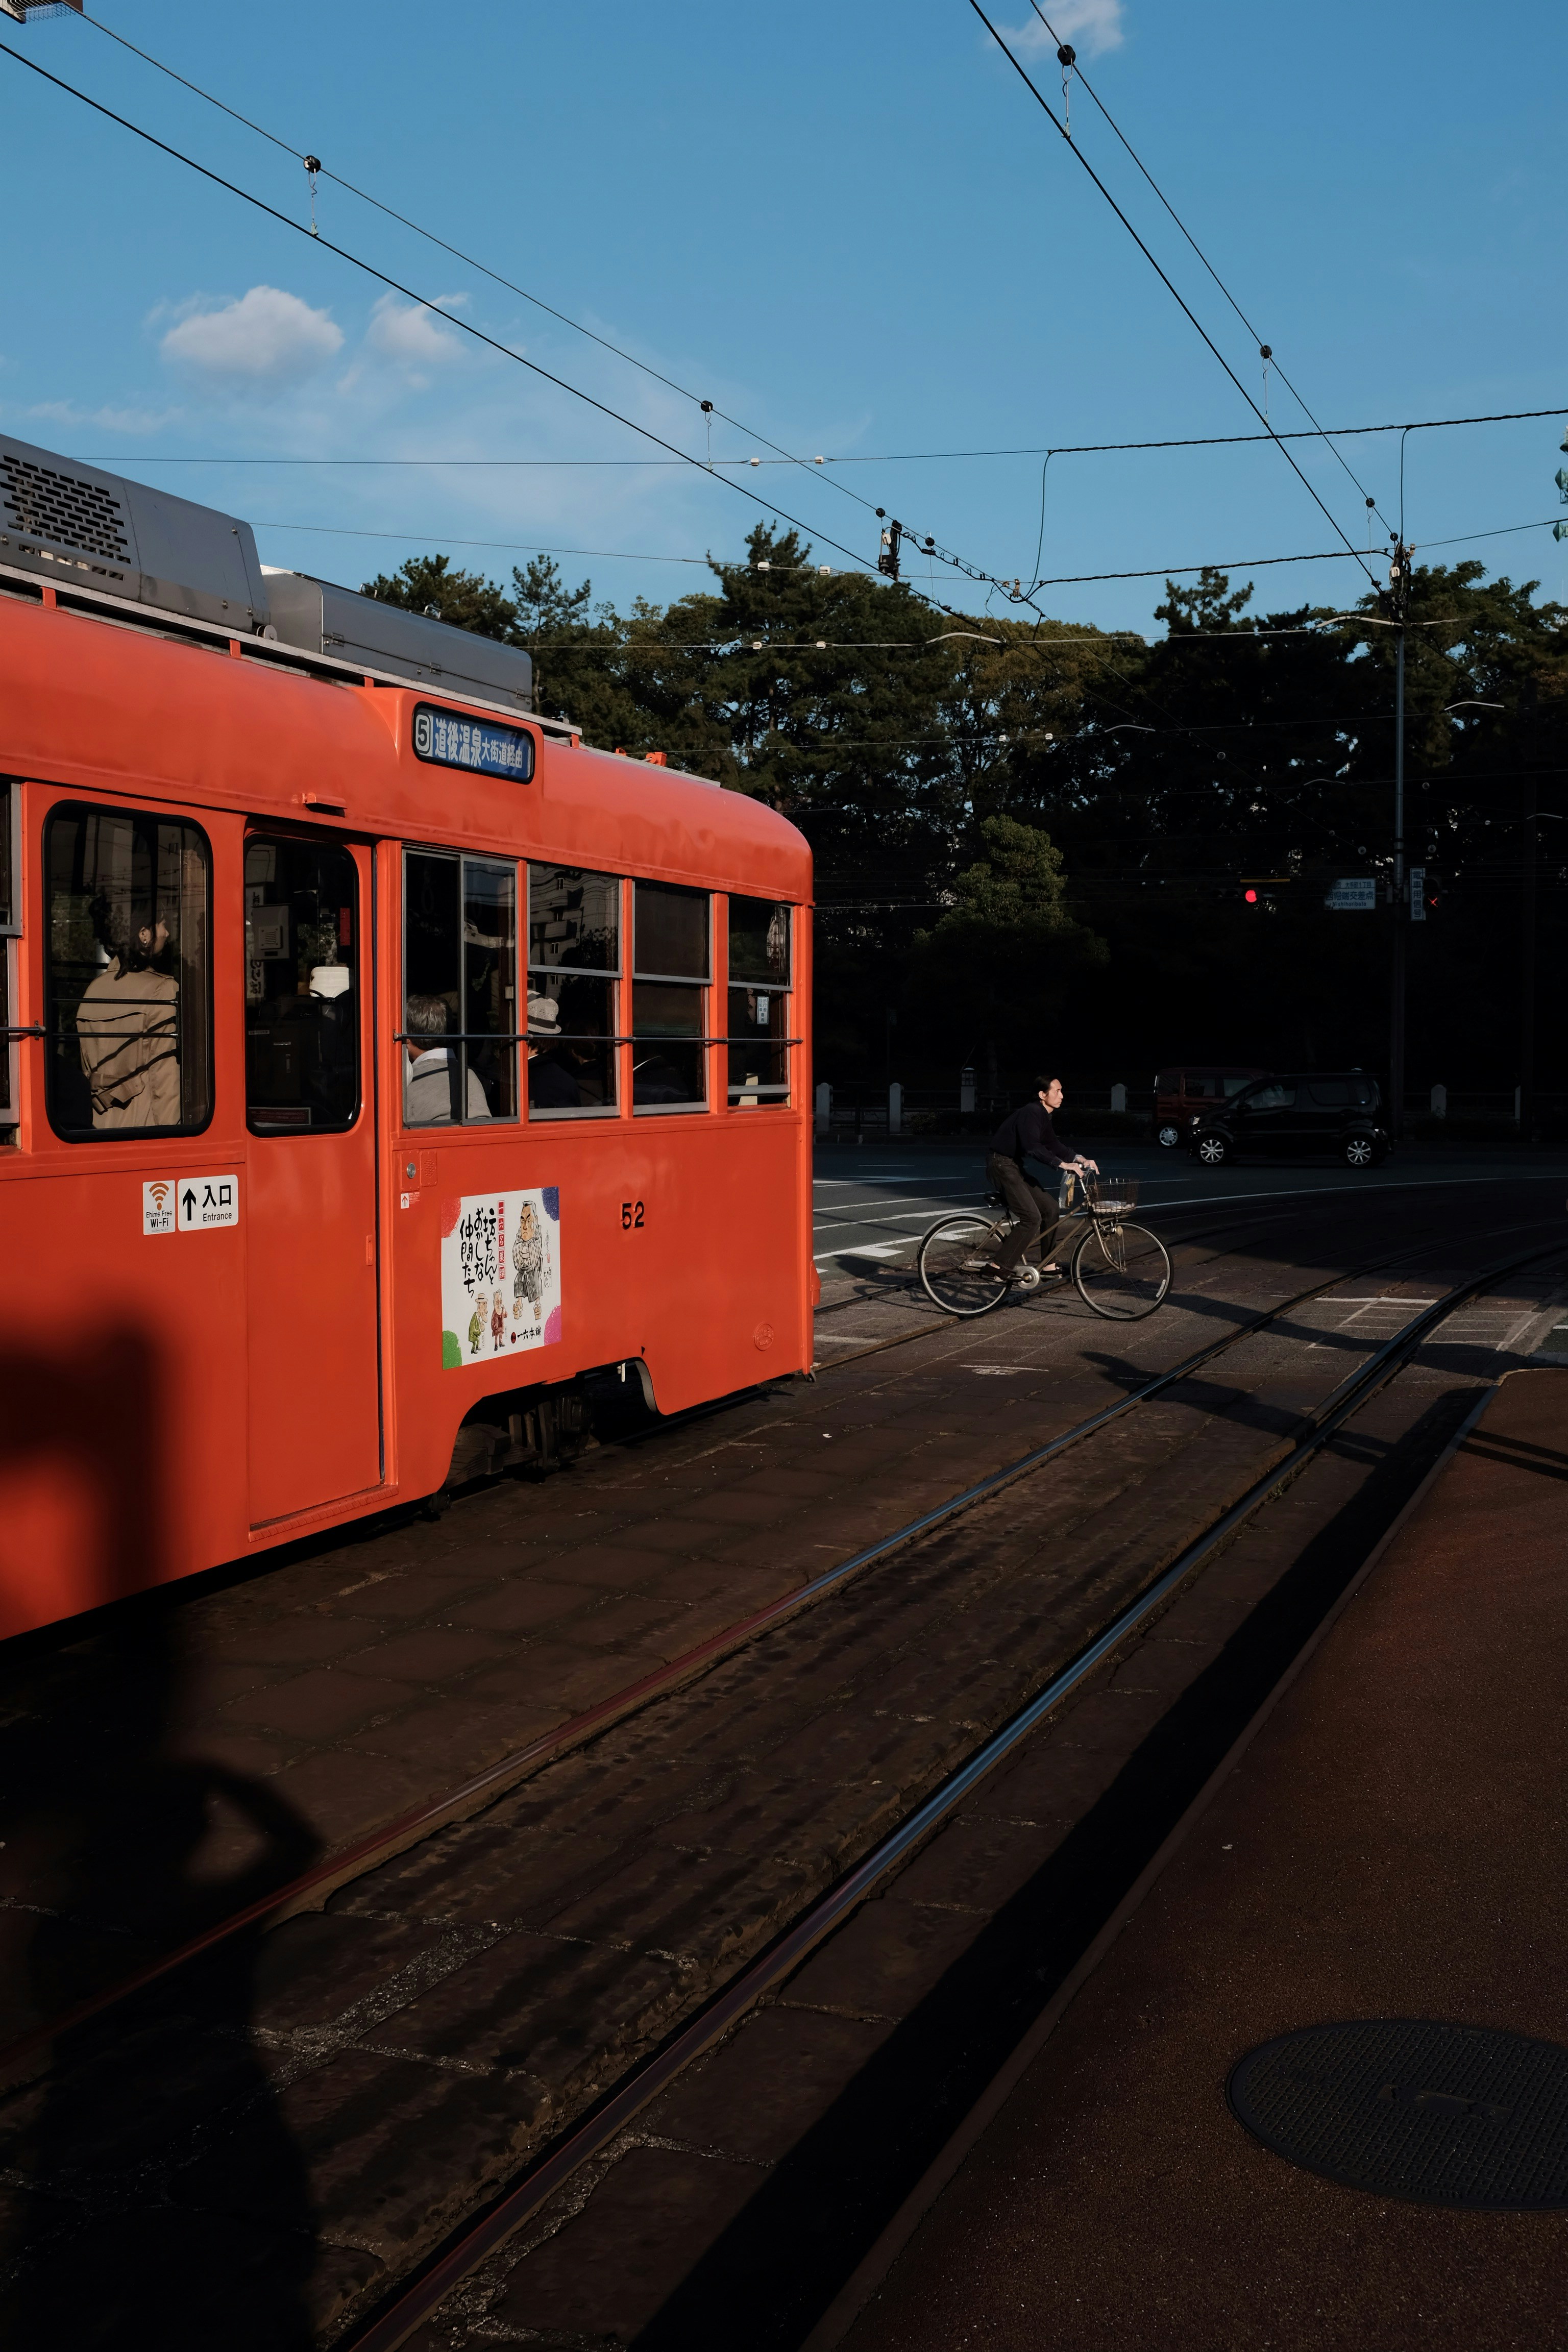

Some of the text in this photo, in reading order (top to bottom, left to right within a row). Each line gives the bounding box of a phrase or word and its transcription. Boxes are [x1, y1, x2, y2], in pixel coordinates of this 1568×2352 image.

[418, 718, 523, 769] 5 道後温泉 大街道経由
[1412, 871, 1422, 917] 電車用信号
[202, 1185, 232, 1209] 入口
[622, 1201, 645, 1230] 52
[150, 1218, 169, 1228] Wi-Fi
[203, 1212, 232, 1222] Entrance
[460, 1214, 475, 1298] 仲間たち
[474, 1207, 484, 1282] おかしな
[483, 1208, 498, 1285] 坊っちゃんと
[517, 1325, 542, 1340] 一六本舗
